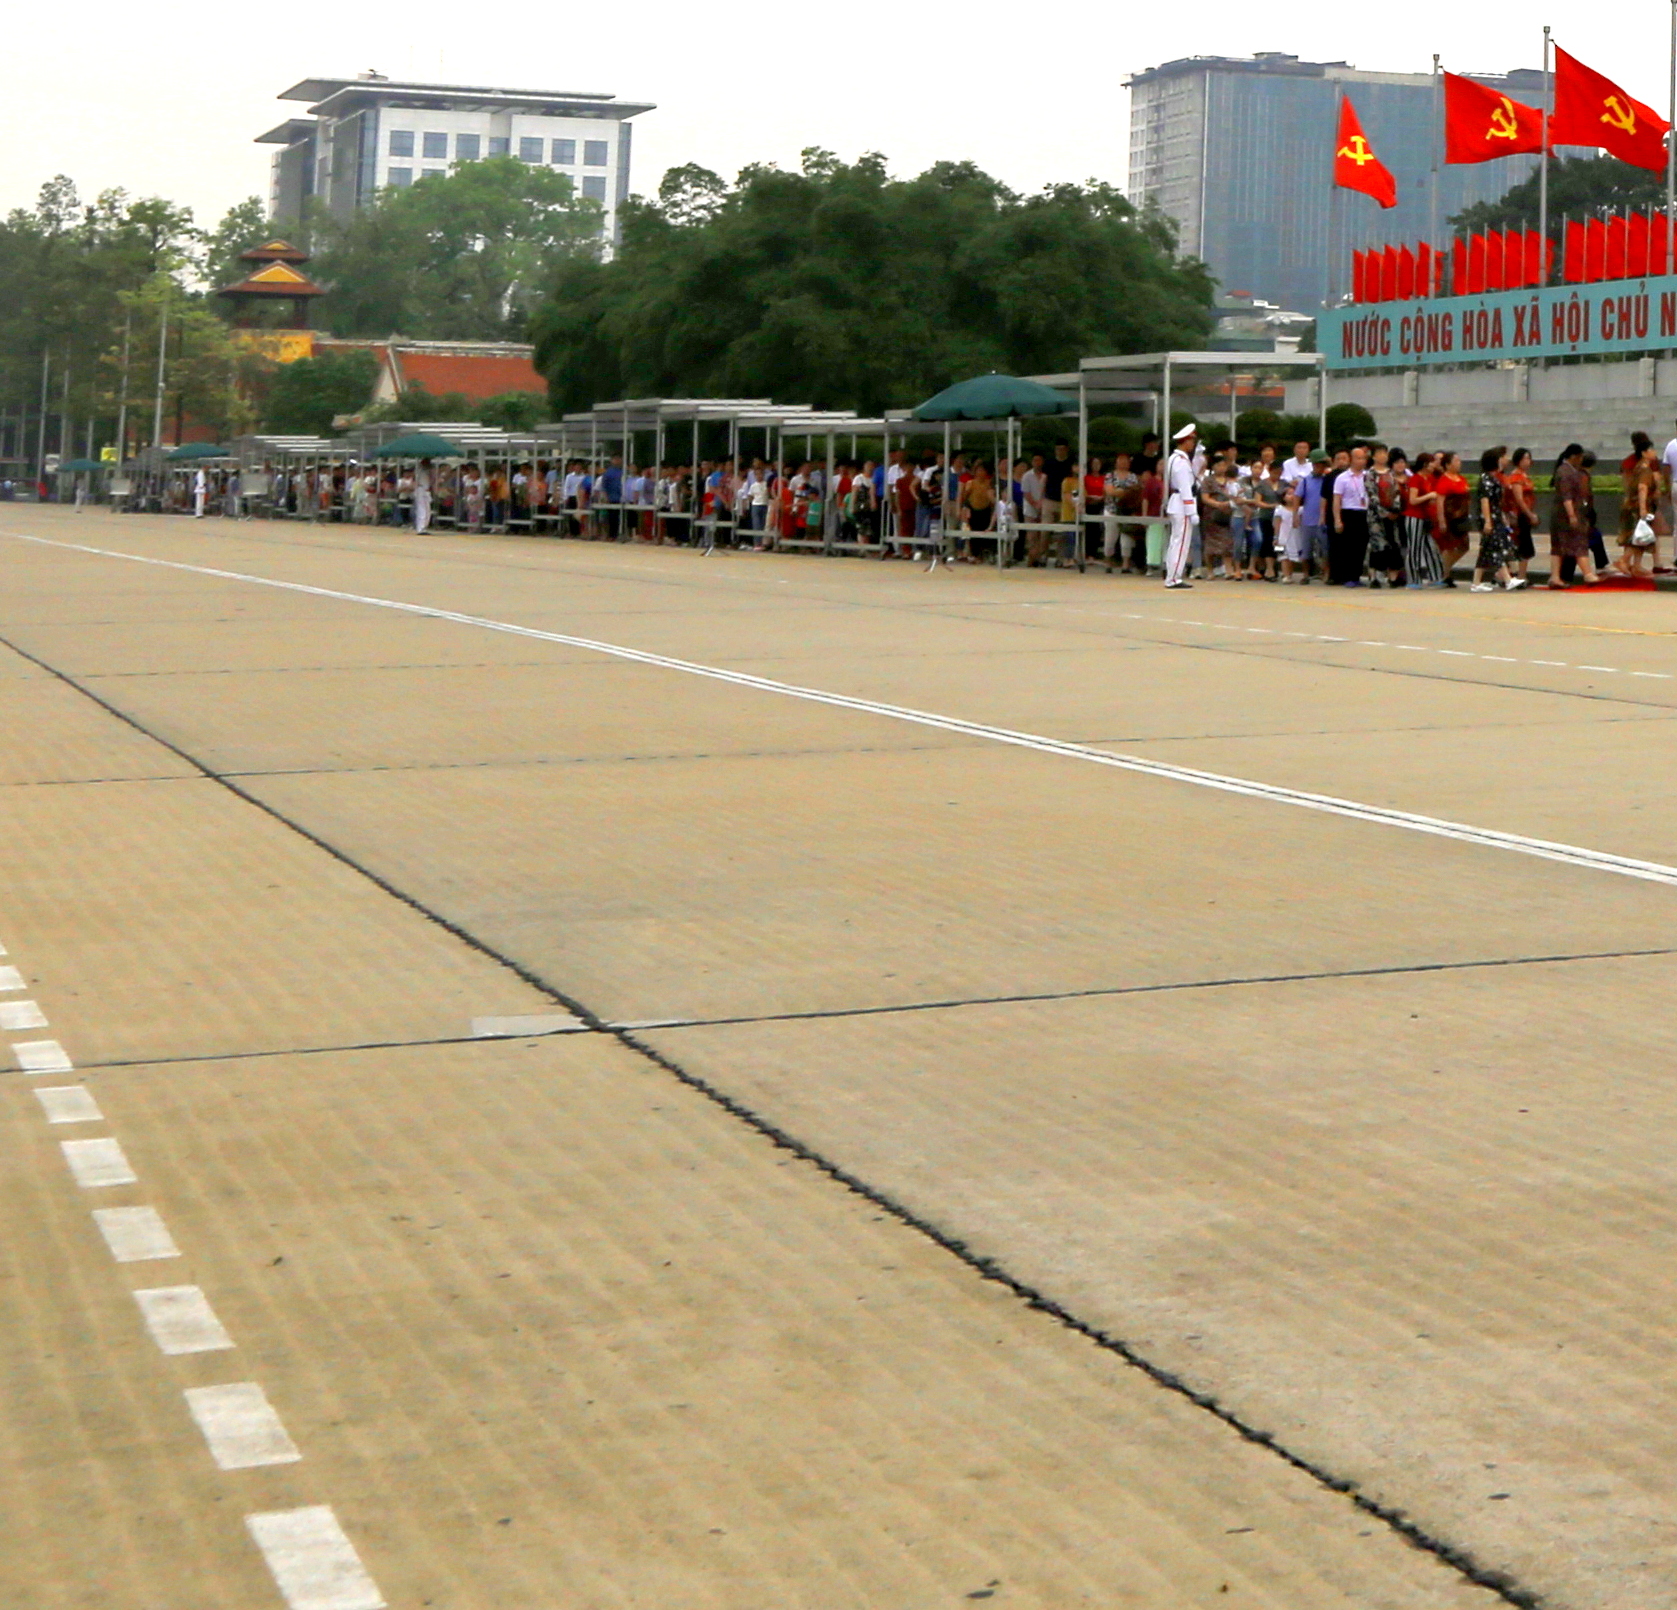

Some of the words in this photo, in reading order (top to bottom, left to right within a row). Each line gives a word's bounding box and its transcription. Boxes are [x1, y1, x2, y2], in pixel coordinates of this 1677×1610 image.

[1342, 310, 1391, 358] NƯỚC
[1400, 306, 1453, 361] CỘNG
[1462, 301, 1503, 350] HÒA
[1513, 295, 1541, 347] XÃ
[1551, 291, 1590, 351] HỘI
[1600, 280, 1649, 340] CHỦ
